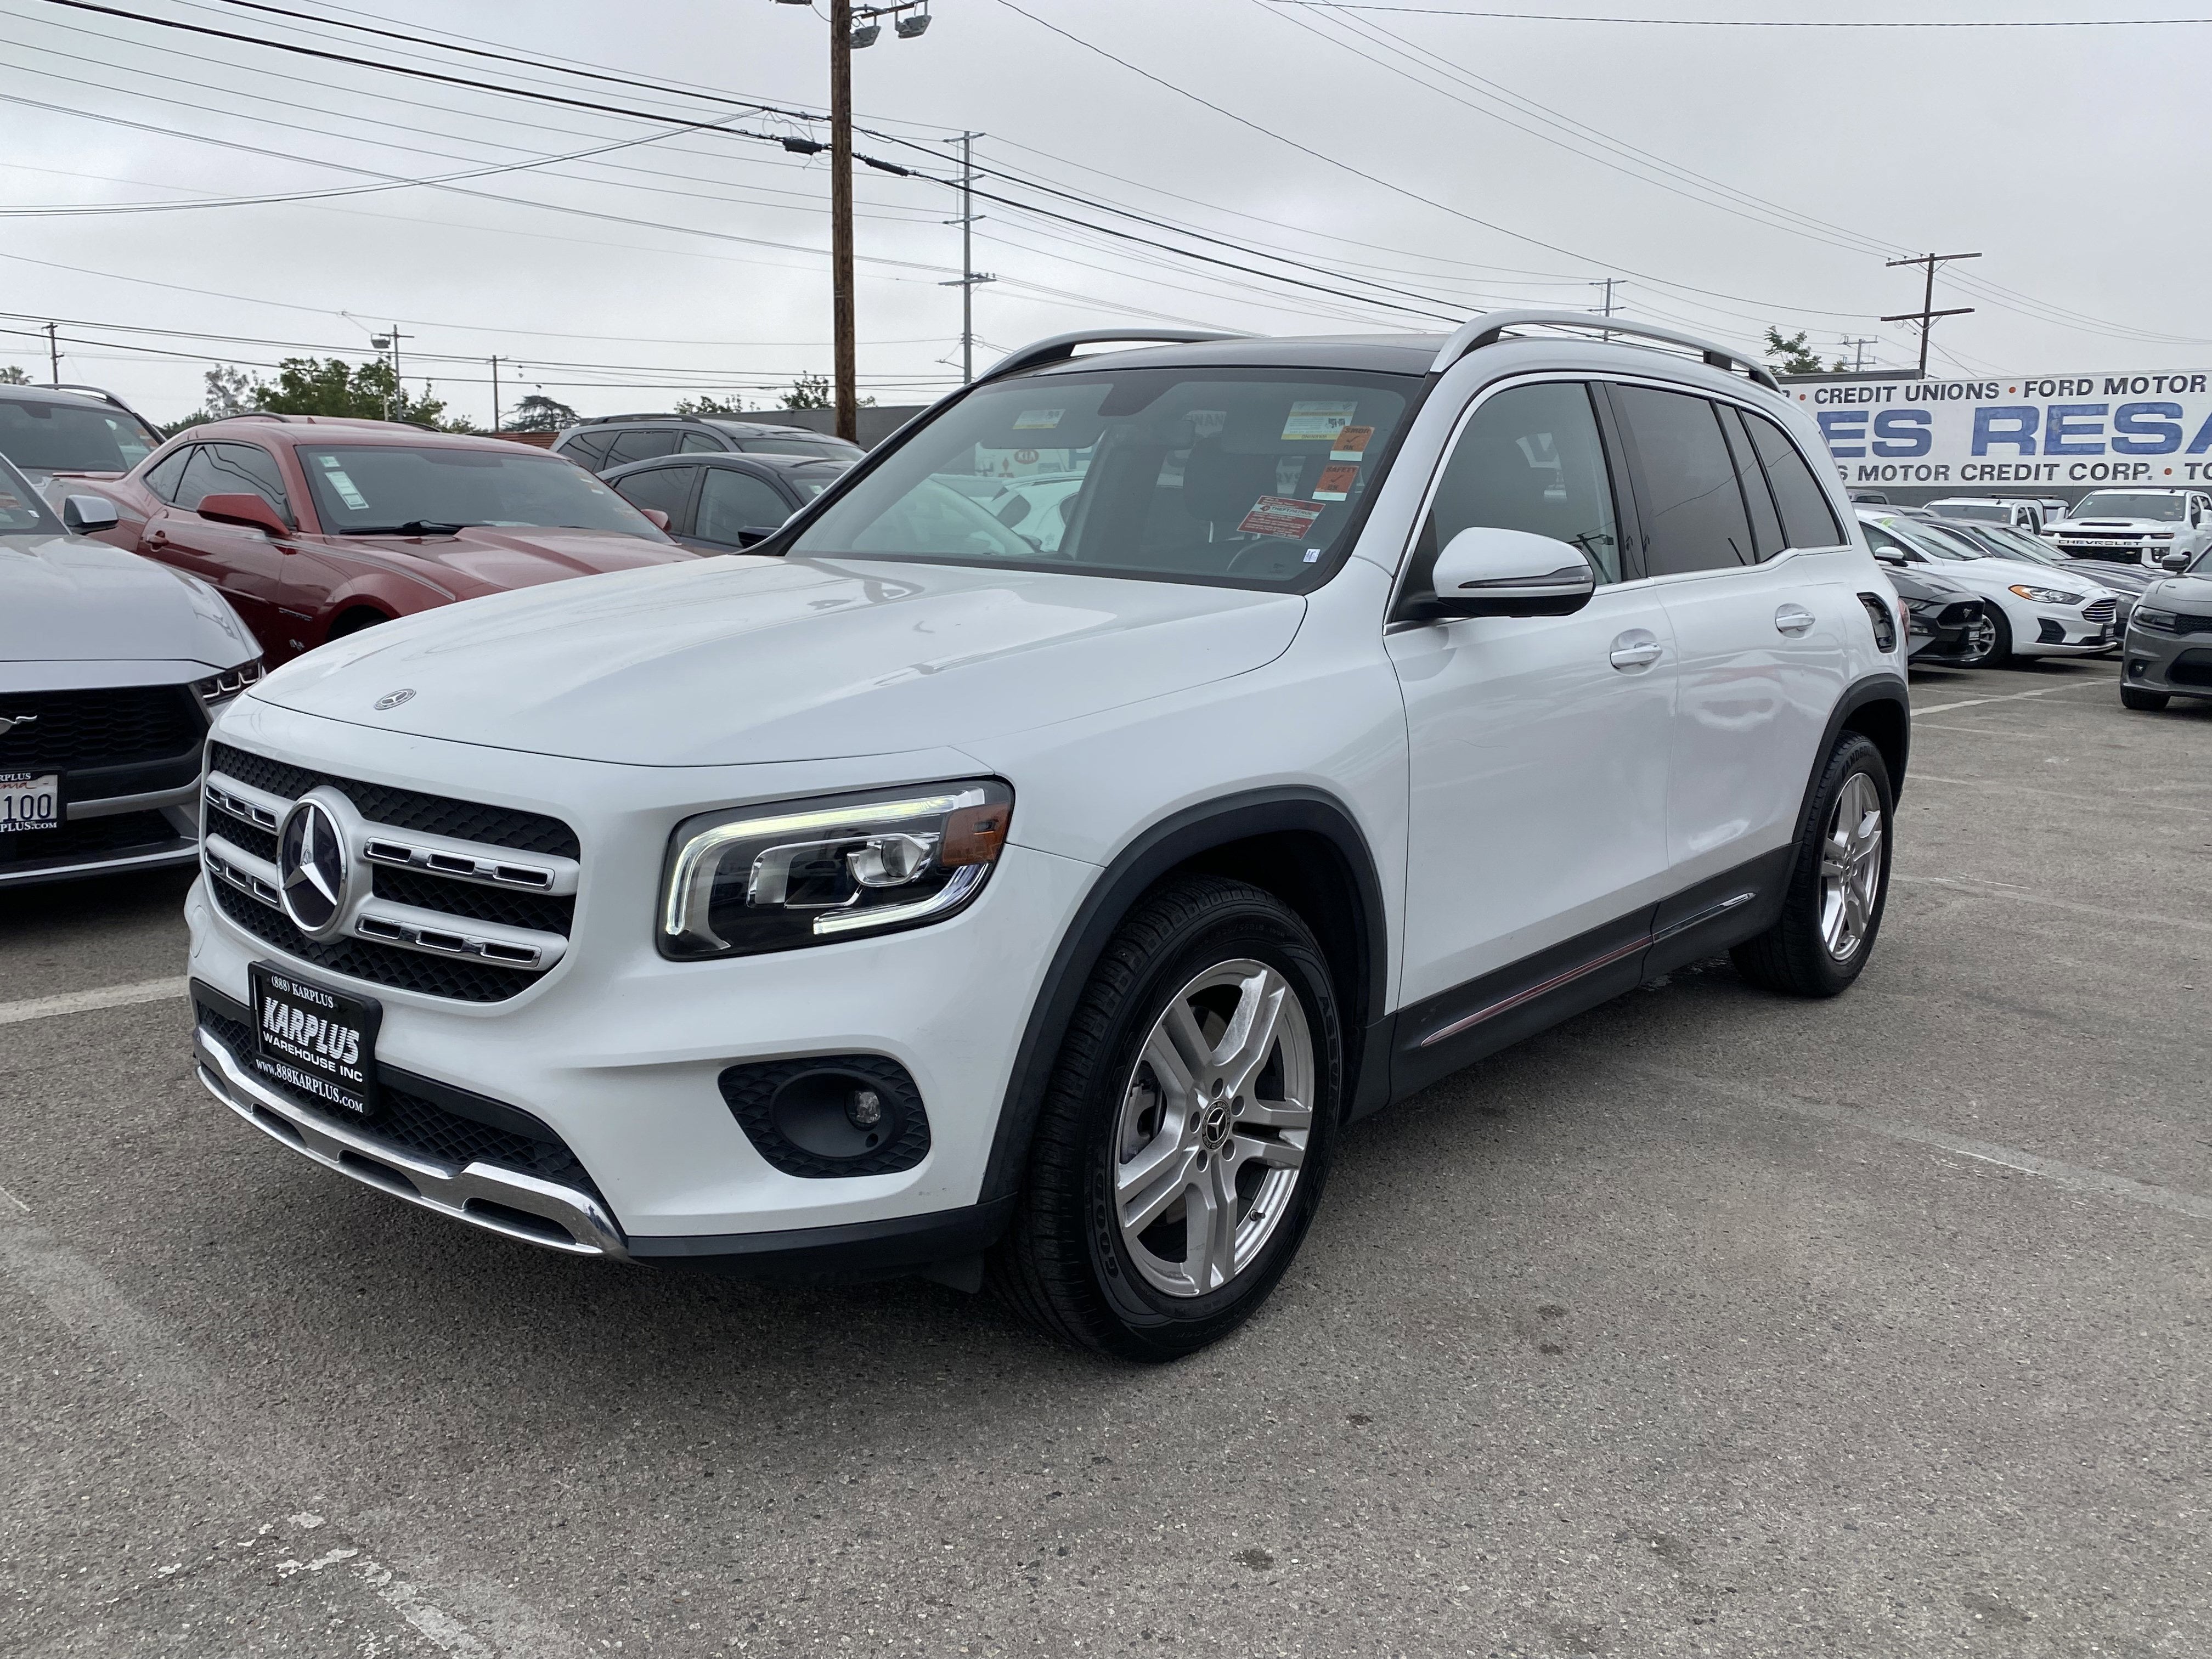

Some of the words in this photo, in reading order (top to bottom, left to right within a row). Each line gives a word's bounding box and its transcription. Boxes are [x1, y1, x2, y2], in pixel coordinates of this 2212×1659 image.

[1814, 386, 1897, 404] CREDIT
[1905, 382, 2000, 402] UNIONS
[2023, 380, 2094, 399] FORD
[2103, 375, 2207, 395] MOTOR
[1858, 464, 1950, 482] MOTOR
[1960, 464, 2060, 481] CREDIT
[2069, 462, 2153, 481] CORP.
[3, 793, 52, 823] 100
[271, 975, 290, 992] (888)
[292, 983, 334, 1008] KARPLUS
[263, 996, 360, 1065] KARPLUS
[263, 1030, 336, 1073] WAREHOUSE
[340, 1065, 363, 1082] INC
